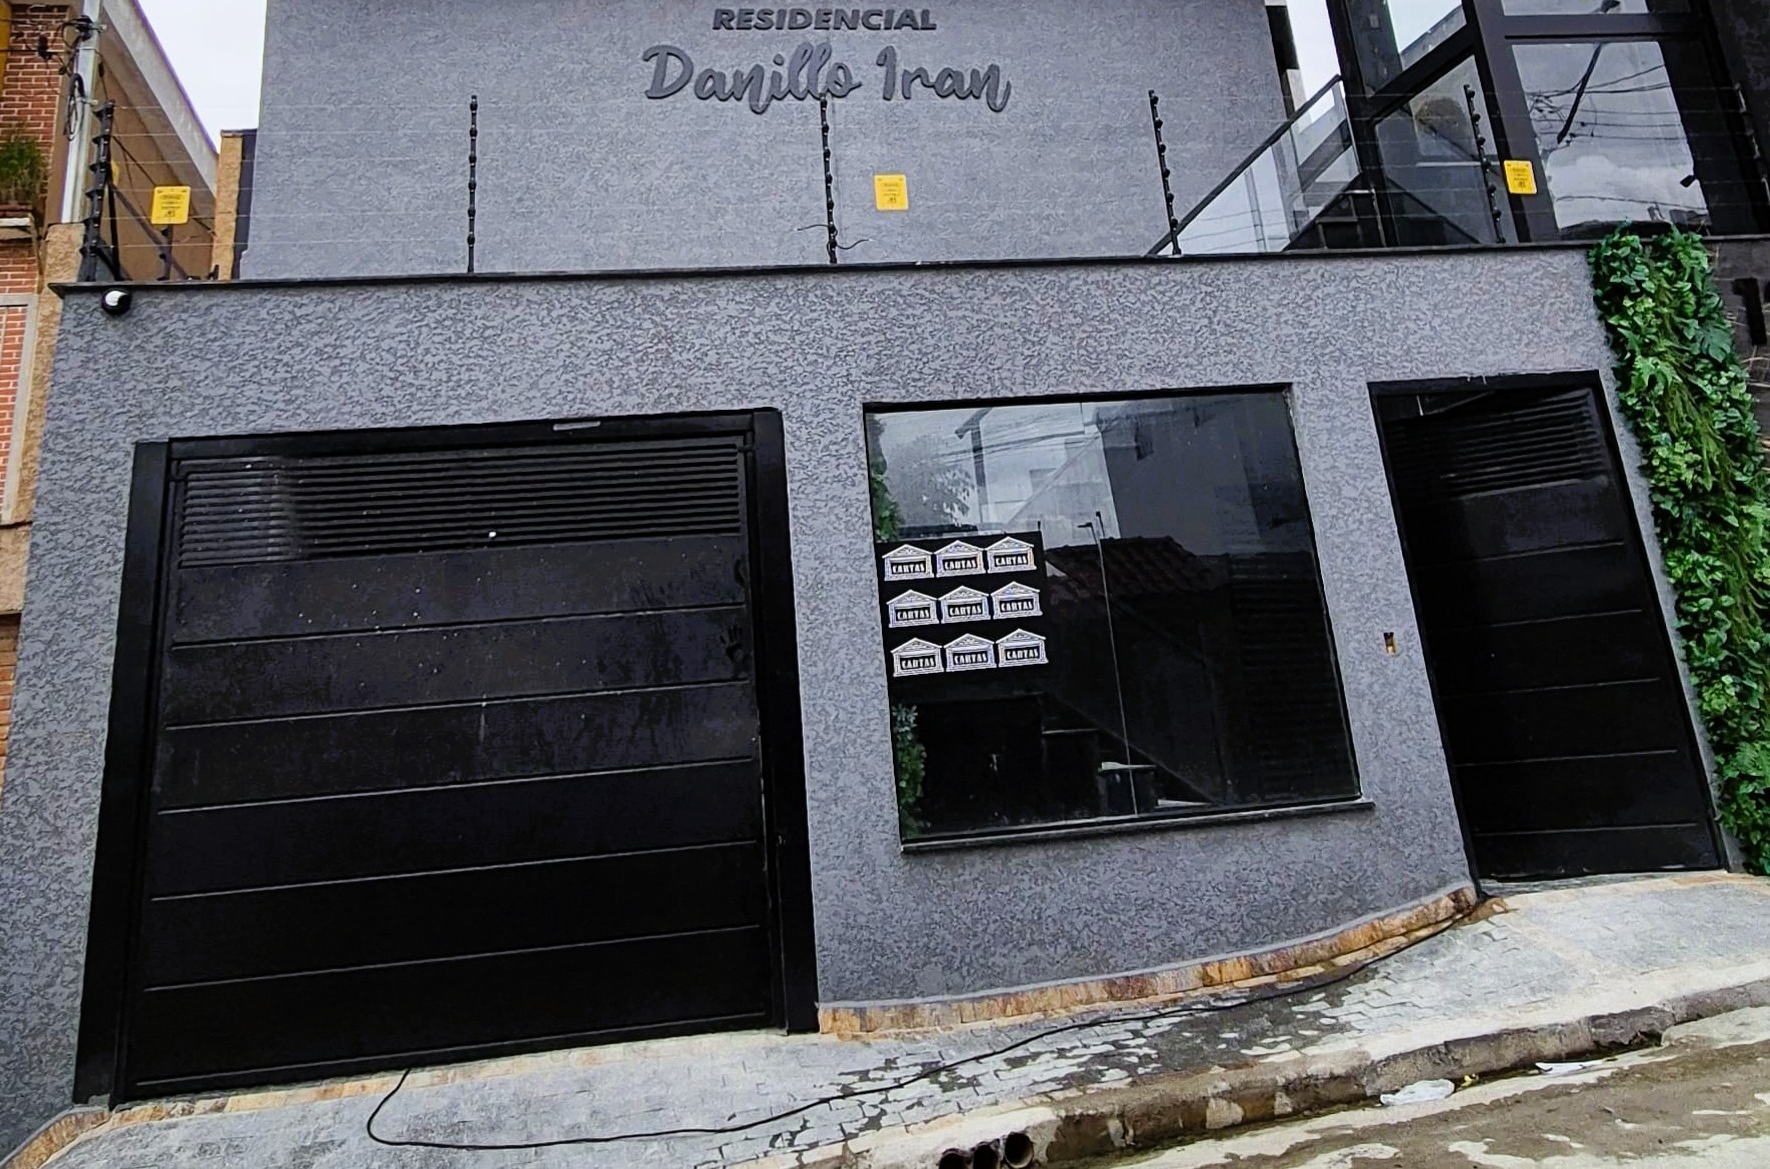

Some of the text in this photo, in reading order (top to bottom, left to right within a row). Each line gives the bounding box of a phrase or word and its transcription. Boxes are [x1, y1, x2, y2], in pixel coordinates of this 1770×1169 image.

[712, 8, 937, 31] RESIDENCIAL
[642, 42, 1011, 115] Danillo Iran
[943, 559, 977, 571] CARTAS
[995, 554, 1028, 567] CARTAS
[892, 563, 926, 574] CARTAS
[949, 604, 983, 616] CARTAS
[1000, 600, 1034, 612] CARTAS
[896, 608, 931, 621] CARTAS
[954, 651, 988, 665] CARTAS
[1006, 647, 1039, 660] CARTAS
[901, 656, 936, 670] CARTAS
